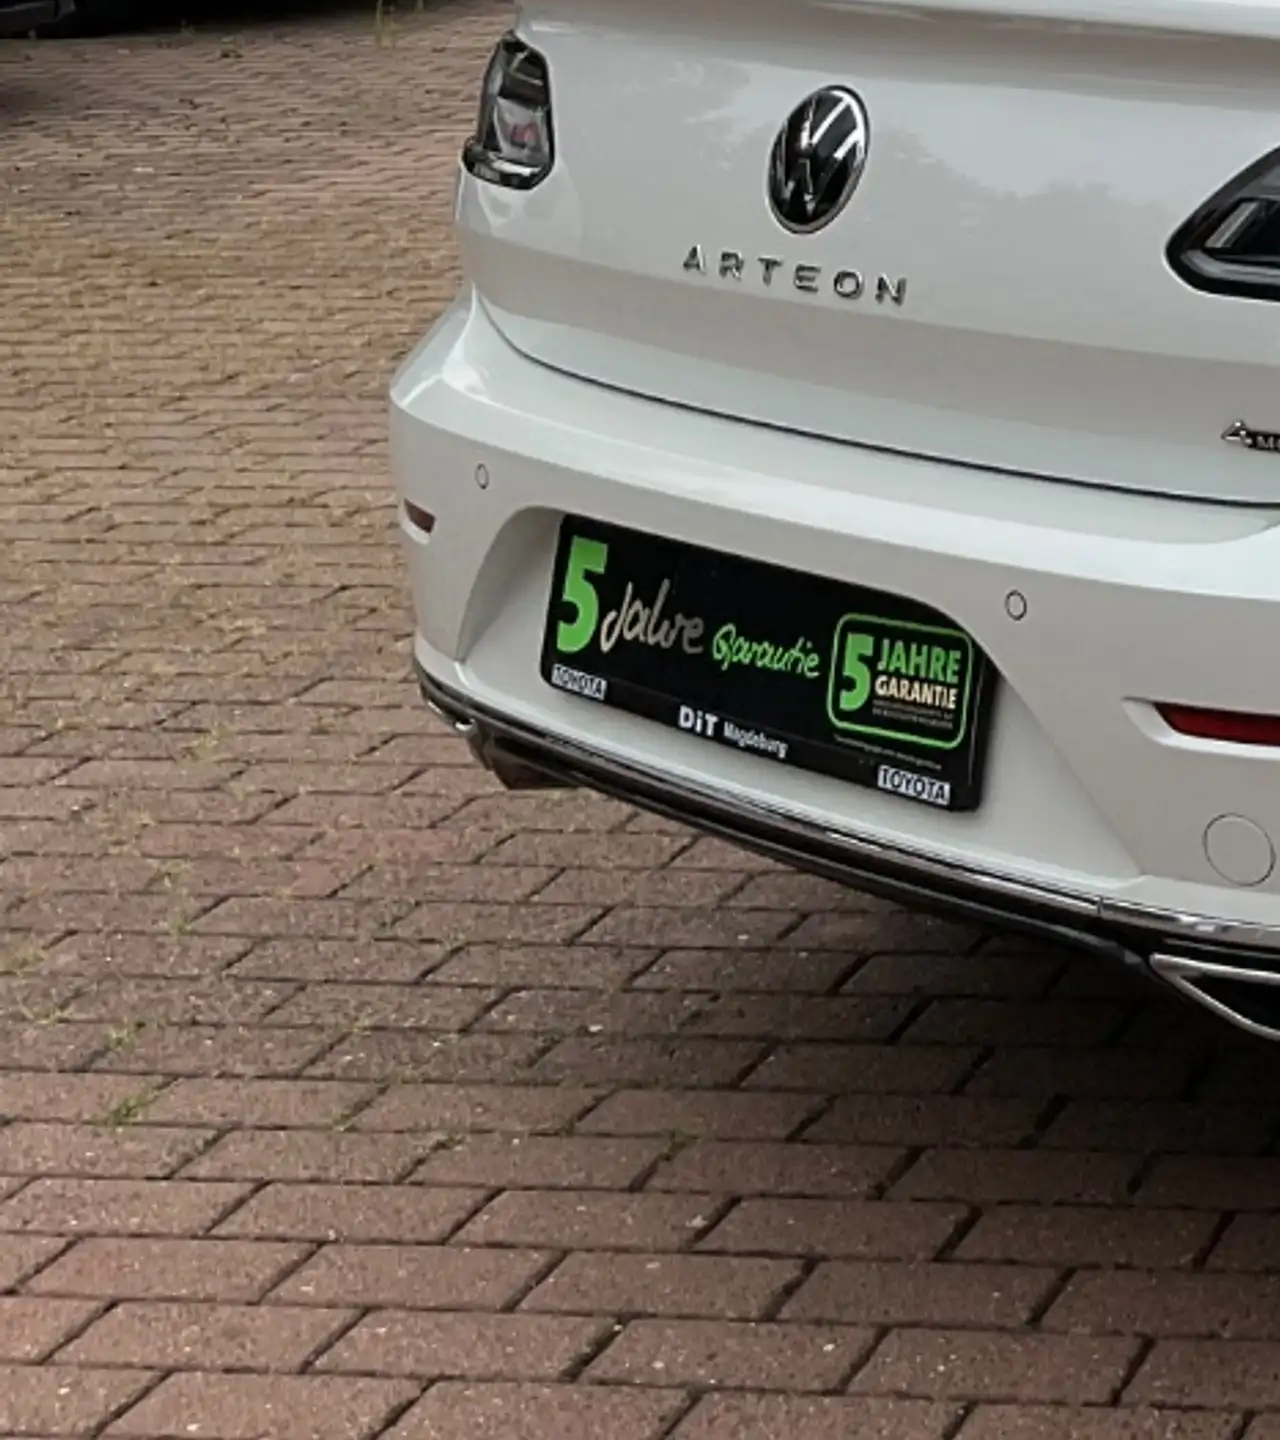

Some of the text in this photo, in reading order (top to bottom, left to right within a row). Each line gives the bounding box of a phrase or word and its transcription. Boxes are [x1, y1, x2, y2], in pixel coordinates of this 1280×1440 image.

[682, 243, 907, 308] ARTEON
[556, 534, 821, 679] 5 Jahre Garantie
[839, 631, 962, 711] 5 JAHRE
[874, 674, 959, 710] GARANTIE
[678, 704, 789, 759] DiT Magdeburg
[877, 764, 950, 806] TOYOTA
